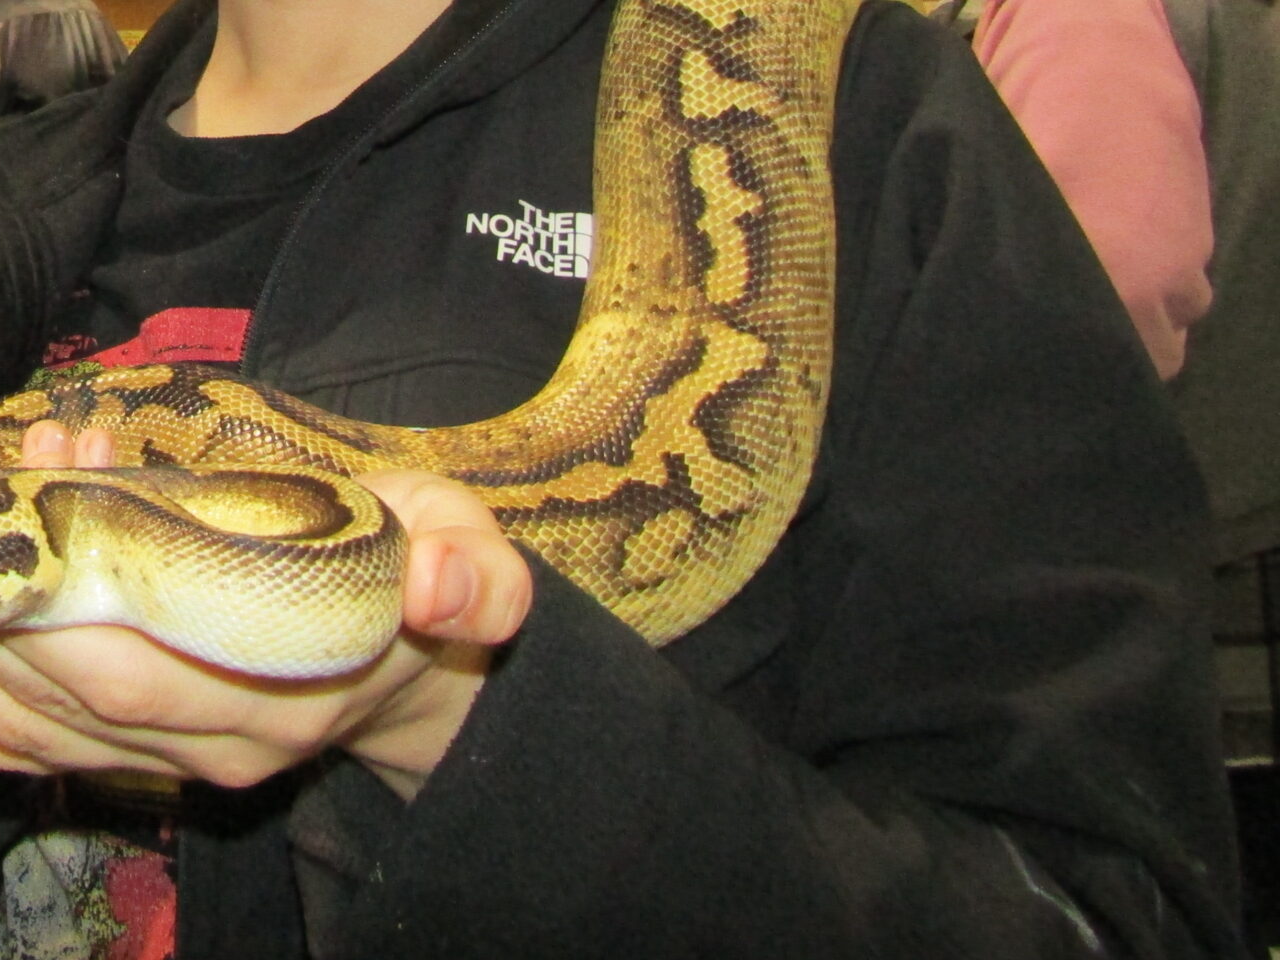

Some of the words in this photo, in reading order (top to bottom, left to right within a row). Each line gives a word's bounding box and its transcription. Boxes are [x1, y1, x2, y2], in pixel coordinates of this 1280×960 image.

[465, 212, 574, 255] NORTH
[518, 199, 574, 234] THE
[496, 238, 574, 278] FACE
